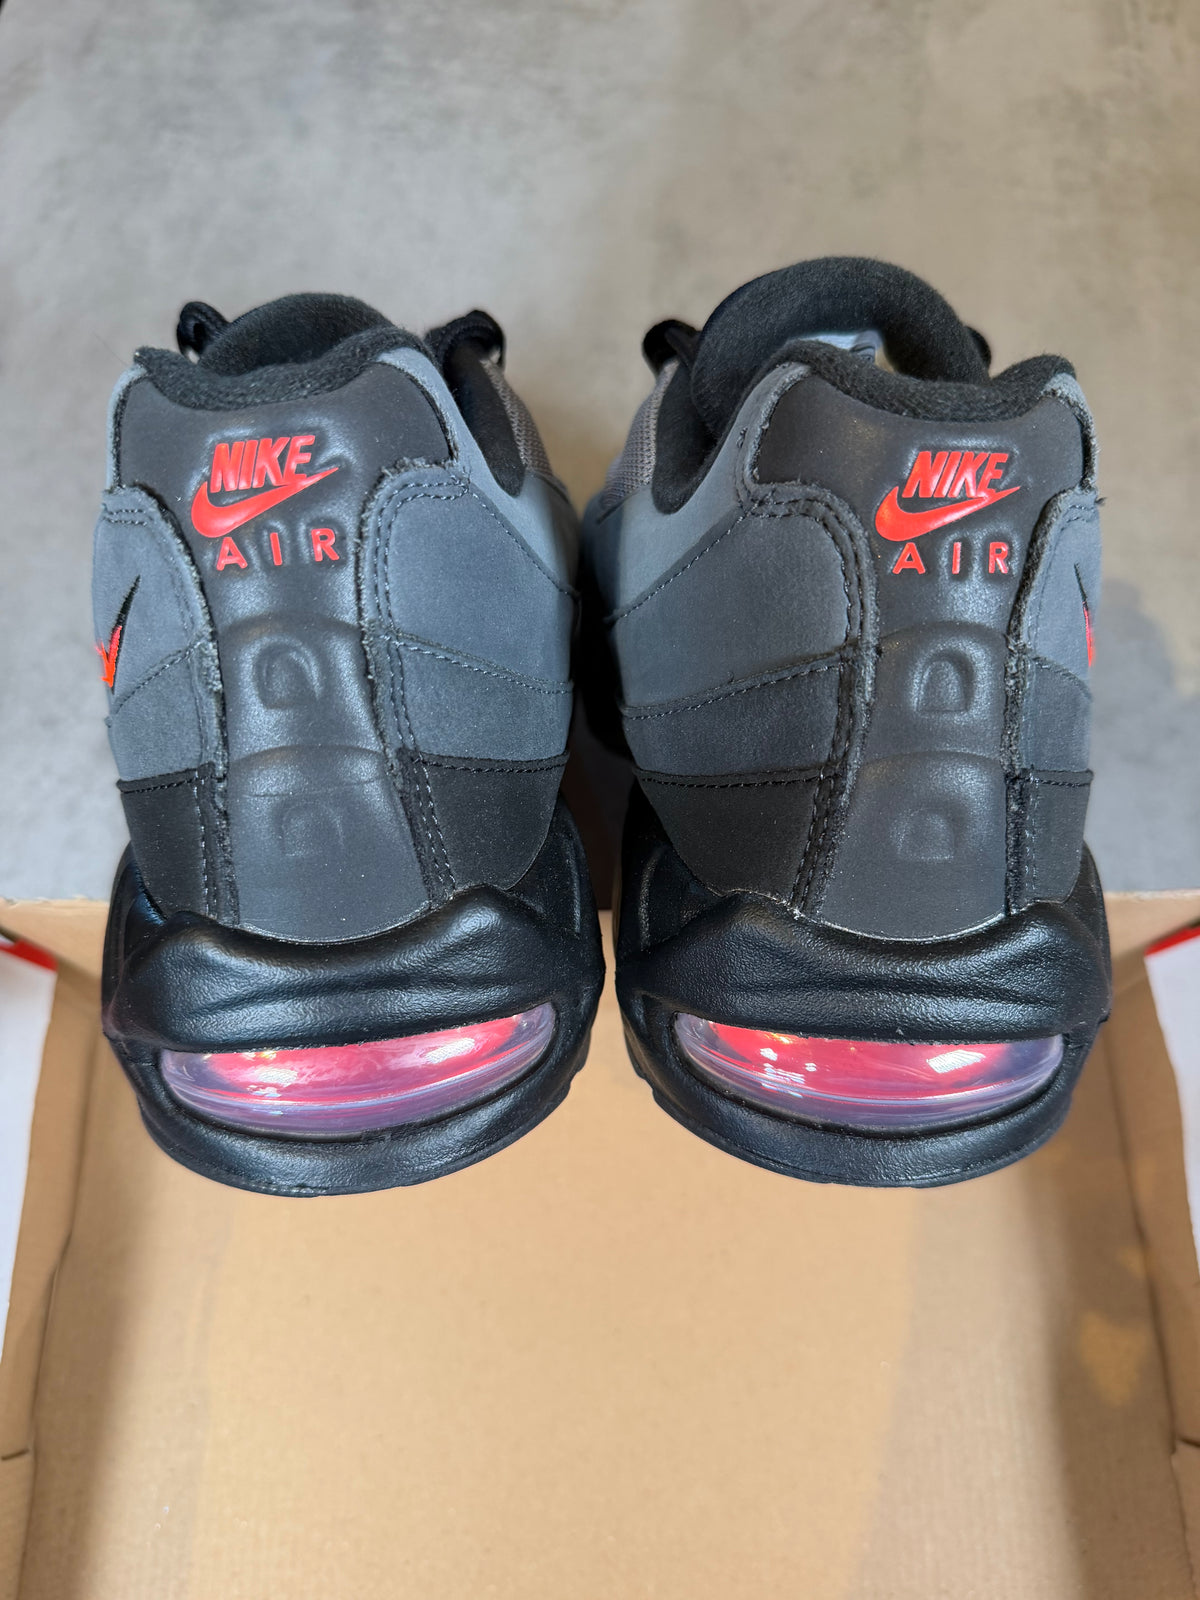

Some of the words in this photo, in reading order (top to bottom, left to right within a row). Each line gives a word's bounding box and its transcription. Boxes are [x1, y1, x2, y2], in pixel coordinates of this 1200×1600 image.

[210, 435, 316, 493] NIKE
[901, 451, 1009, 498] NIKE
[216, 528, 340, 571] AIR
[892, 541, 1009, 575] AIR
